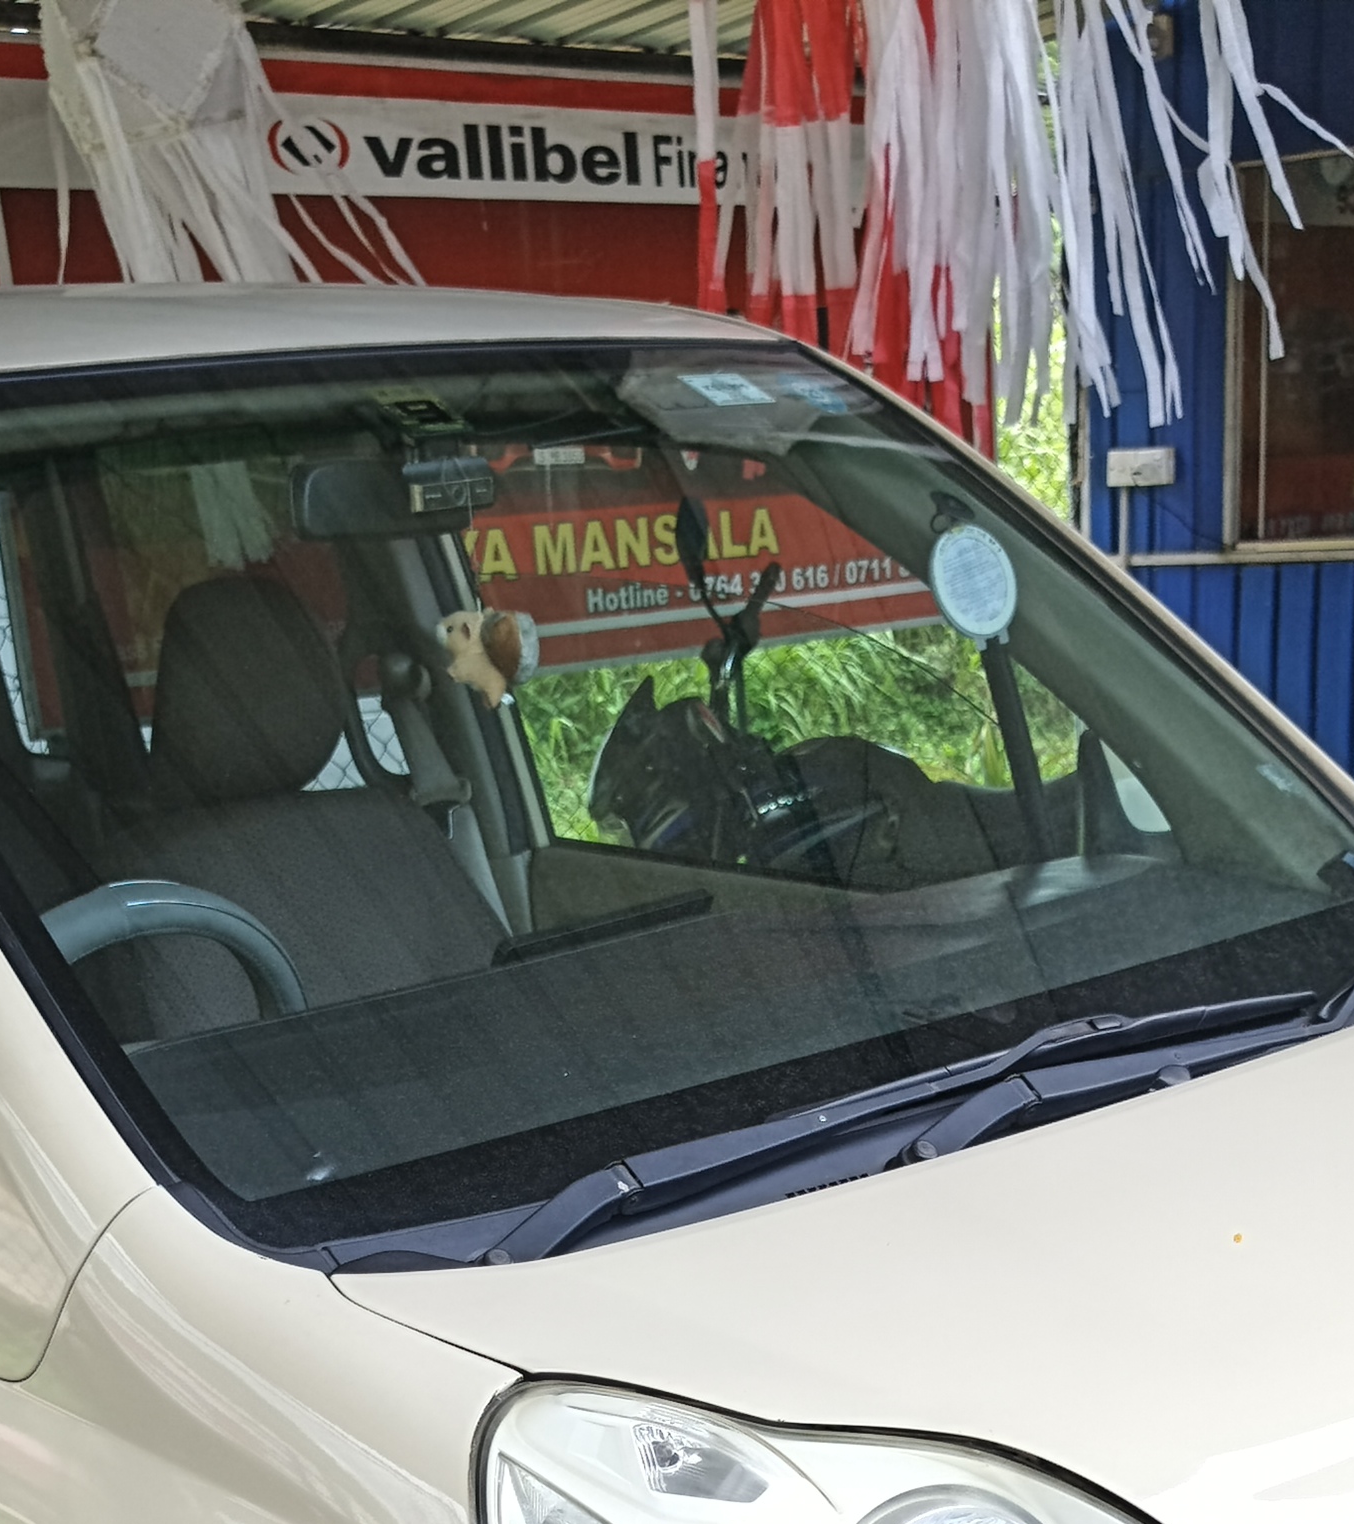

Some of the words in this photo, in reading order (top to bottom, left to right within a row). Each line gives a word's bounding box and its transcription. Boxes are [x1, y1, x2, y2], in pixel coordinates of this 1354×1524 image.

[363, 123, 640, 187] vallibel
[587, 582, 669, 613] Hotline
[749, 570, 786, 594] 30
[792, 564, 829, 591] 616
[846, 557, 892, 584] 0711
